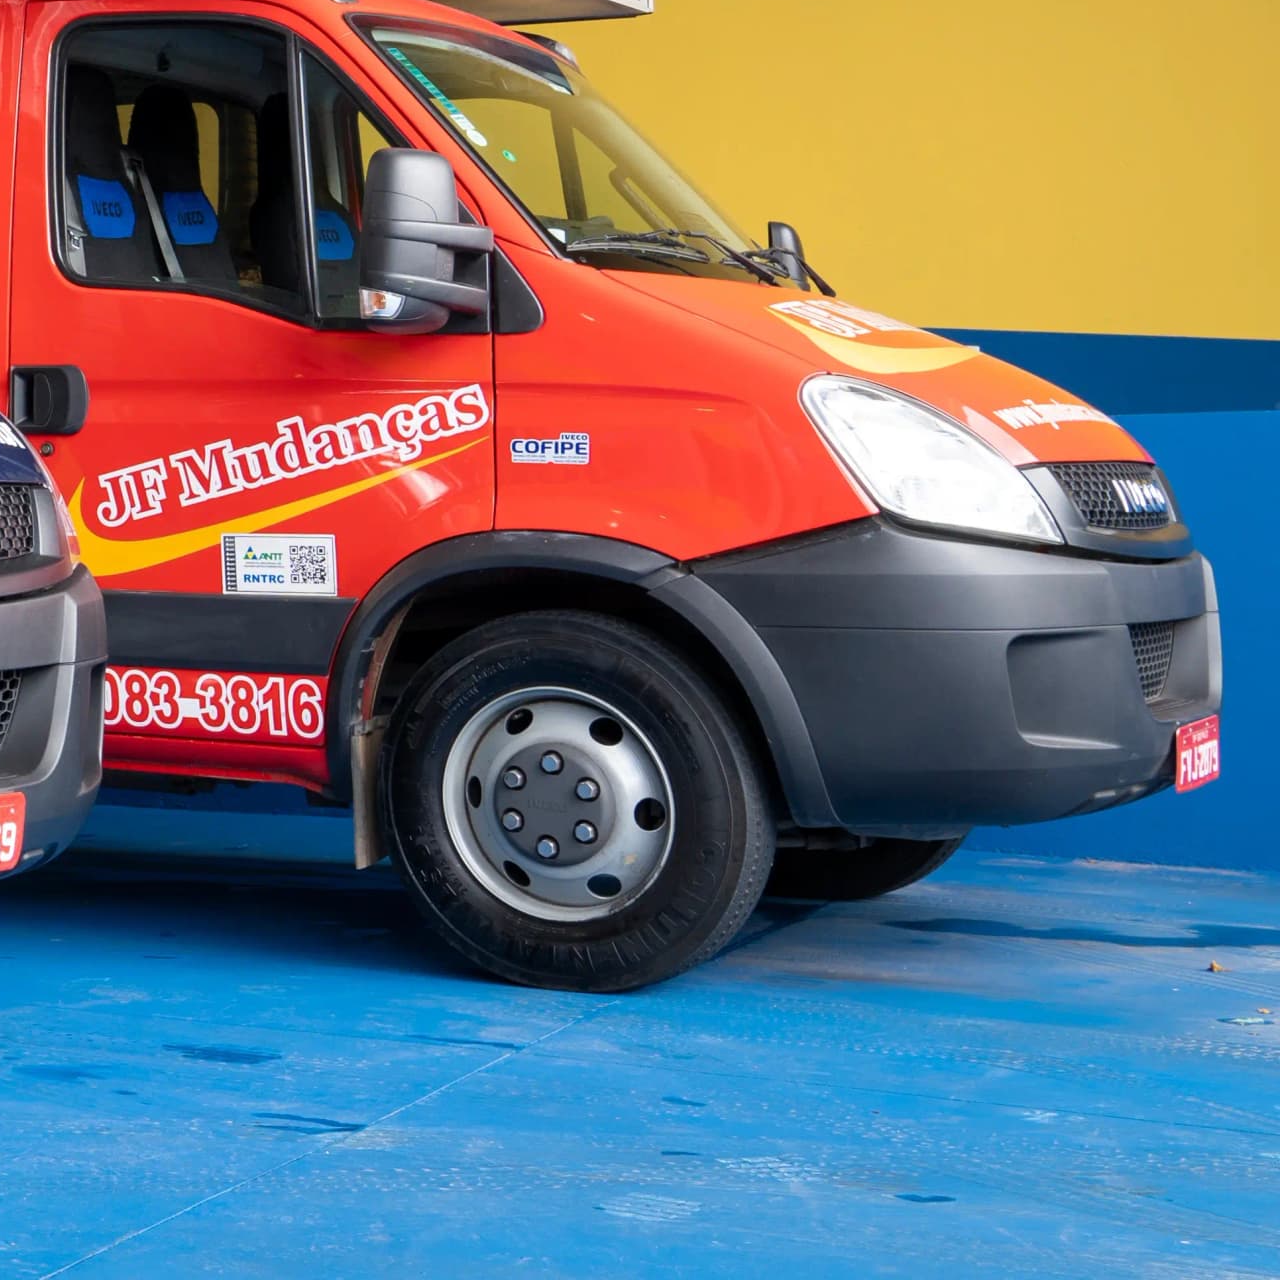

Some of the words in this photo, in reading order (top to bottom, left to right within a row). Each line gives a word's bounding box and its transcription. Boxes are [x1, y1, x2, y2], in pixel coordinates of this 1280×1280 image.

[92, 200, 123, 218] IVECO
[96, 457, 168, 527] JF
[169, 383, 491, 506] Mudanças
[511, 440, 588, 455] COFIPE
[259, 552, 283, 562] ANTT
[243, 573, 285, 585] RNTRC
[104, 668, 325, 740] 083-3816
